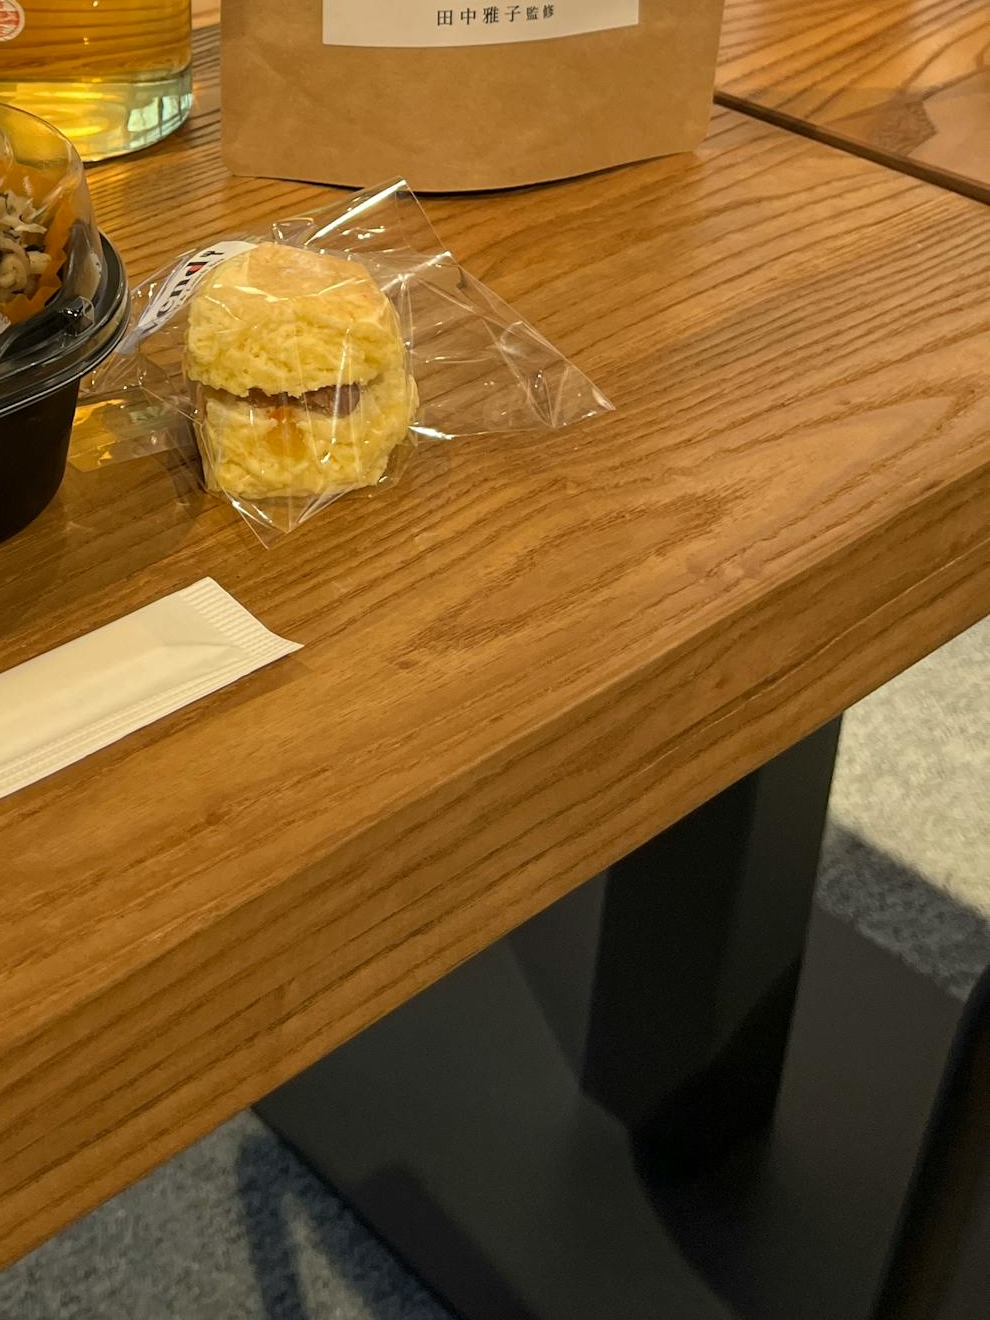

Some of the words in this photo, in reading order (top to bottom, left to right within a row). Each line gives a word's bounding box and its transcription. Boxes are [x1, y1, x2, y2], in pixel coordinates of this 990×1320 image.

[437, 4, 555, 27] 田中雅子監修
